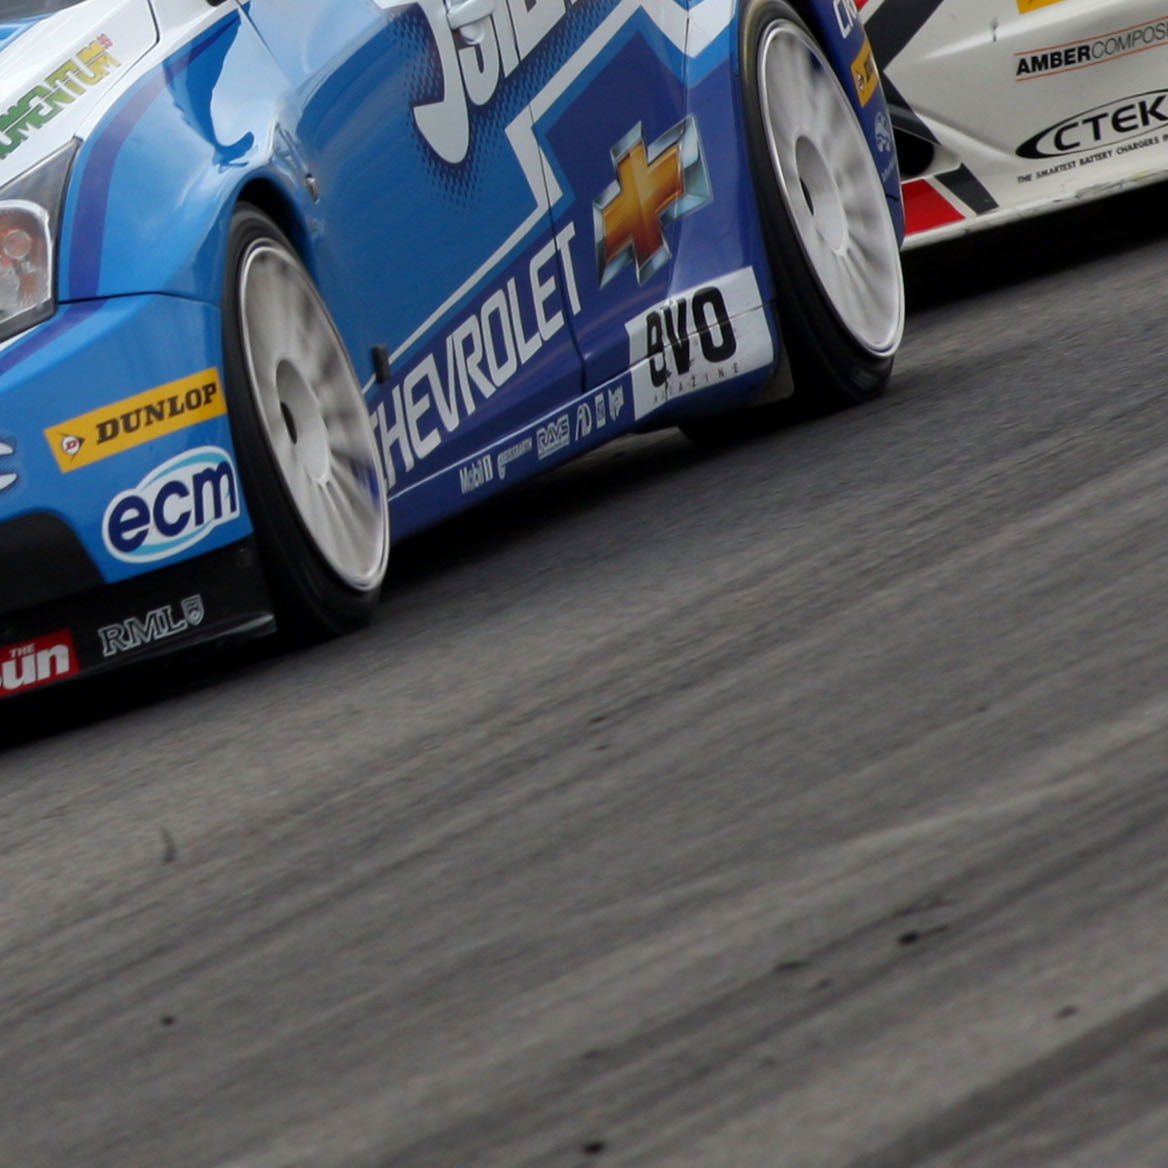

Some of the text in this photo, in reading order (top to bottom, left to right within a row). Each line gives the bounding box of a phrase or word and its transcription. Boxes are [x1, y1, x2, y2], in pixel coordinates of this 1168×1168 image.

[1053, 94, 1168, 152] CTEK
[96, 382, 218, 445] DUNLOP
[108, 460, 238, 553] ecm
[9, 643, 35, 659] THE
